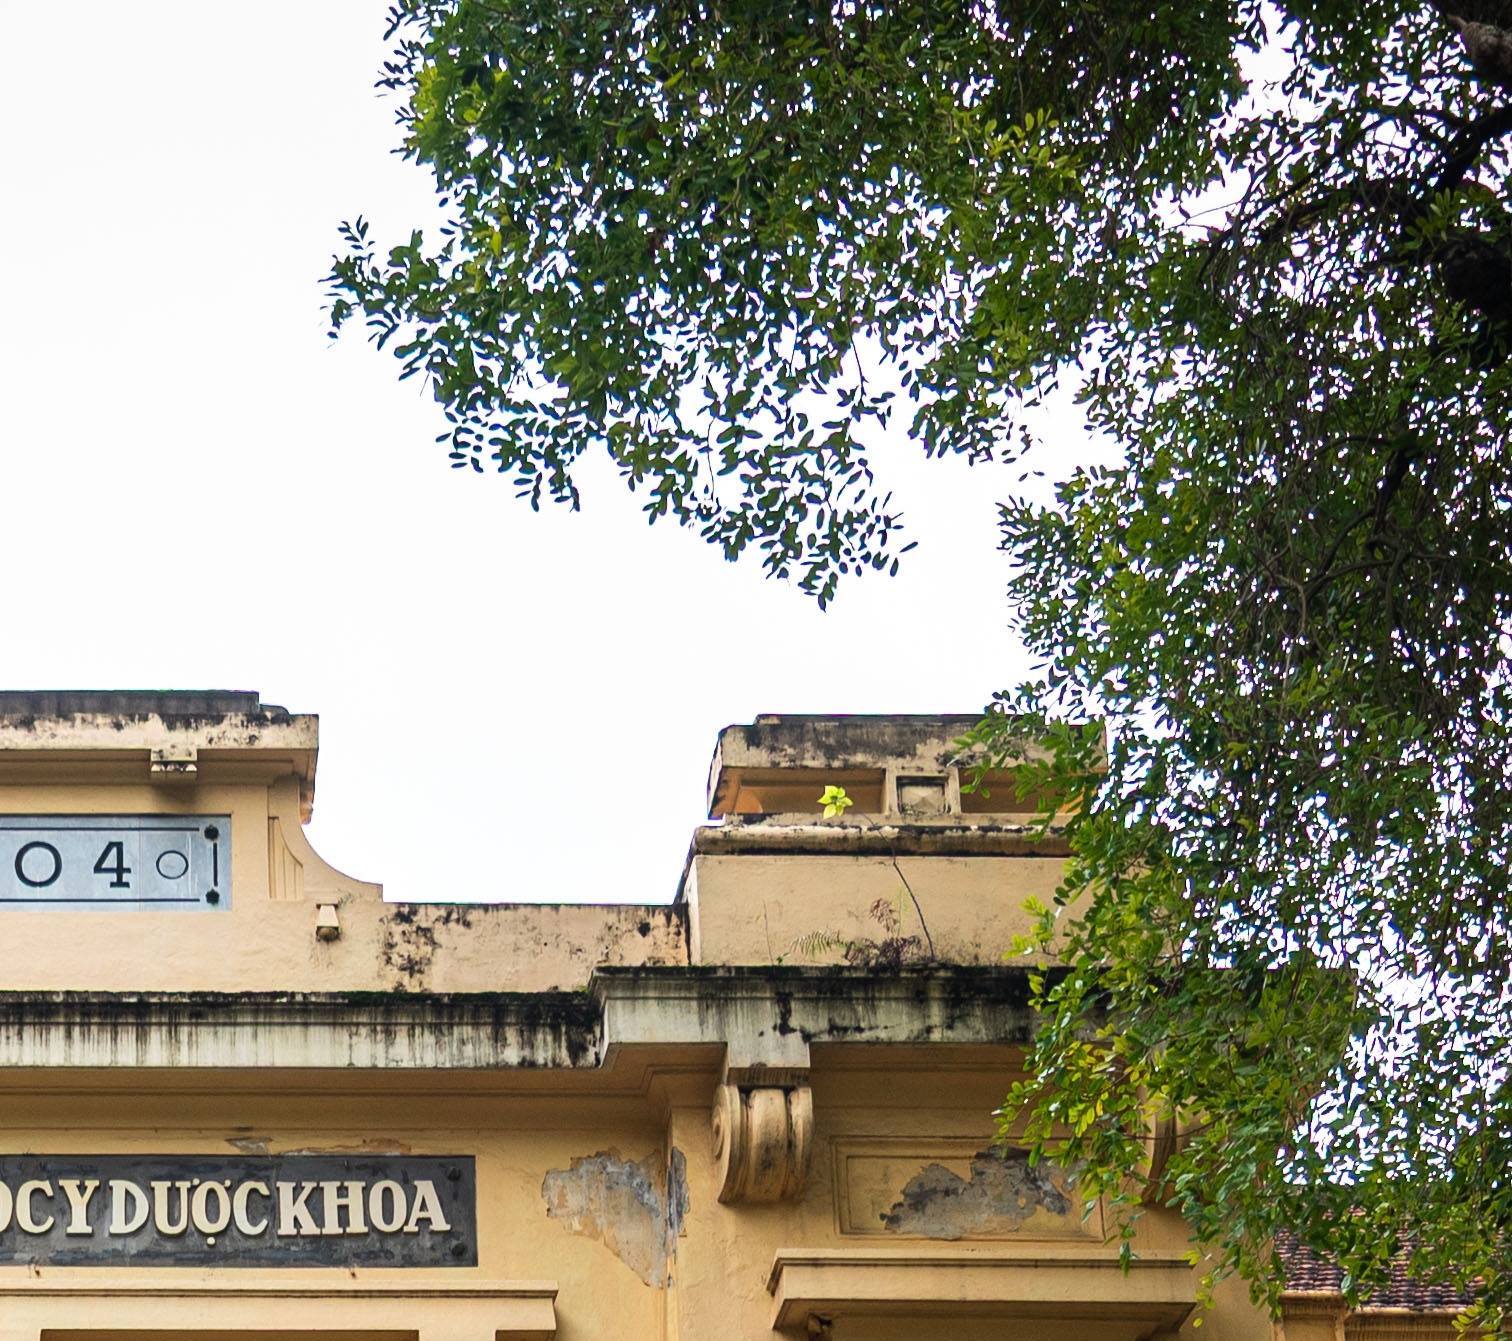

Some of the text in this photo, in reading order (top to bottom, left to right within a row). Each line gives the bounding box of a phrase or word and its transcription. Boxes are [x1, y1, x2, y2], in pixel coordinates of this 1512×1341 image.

[58, 1179, 101, 1235] Y
[108, 1177, 271, 1247] DƯỢC
[276, 1179, 452, 1237] KHOA
